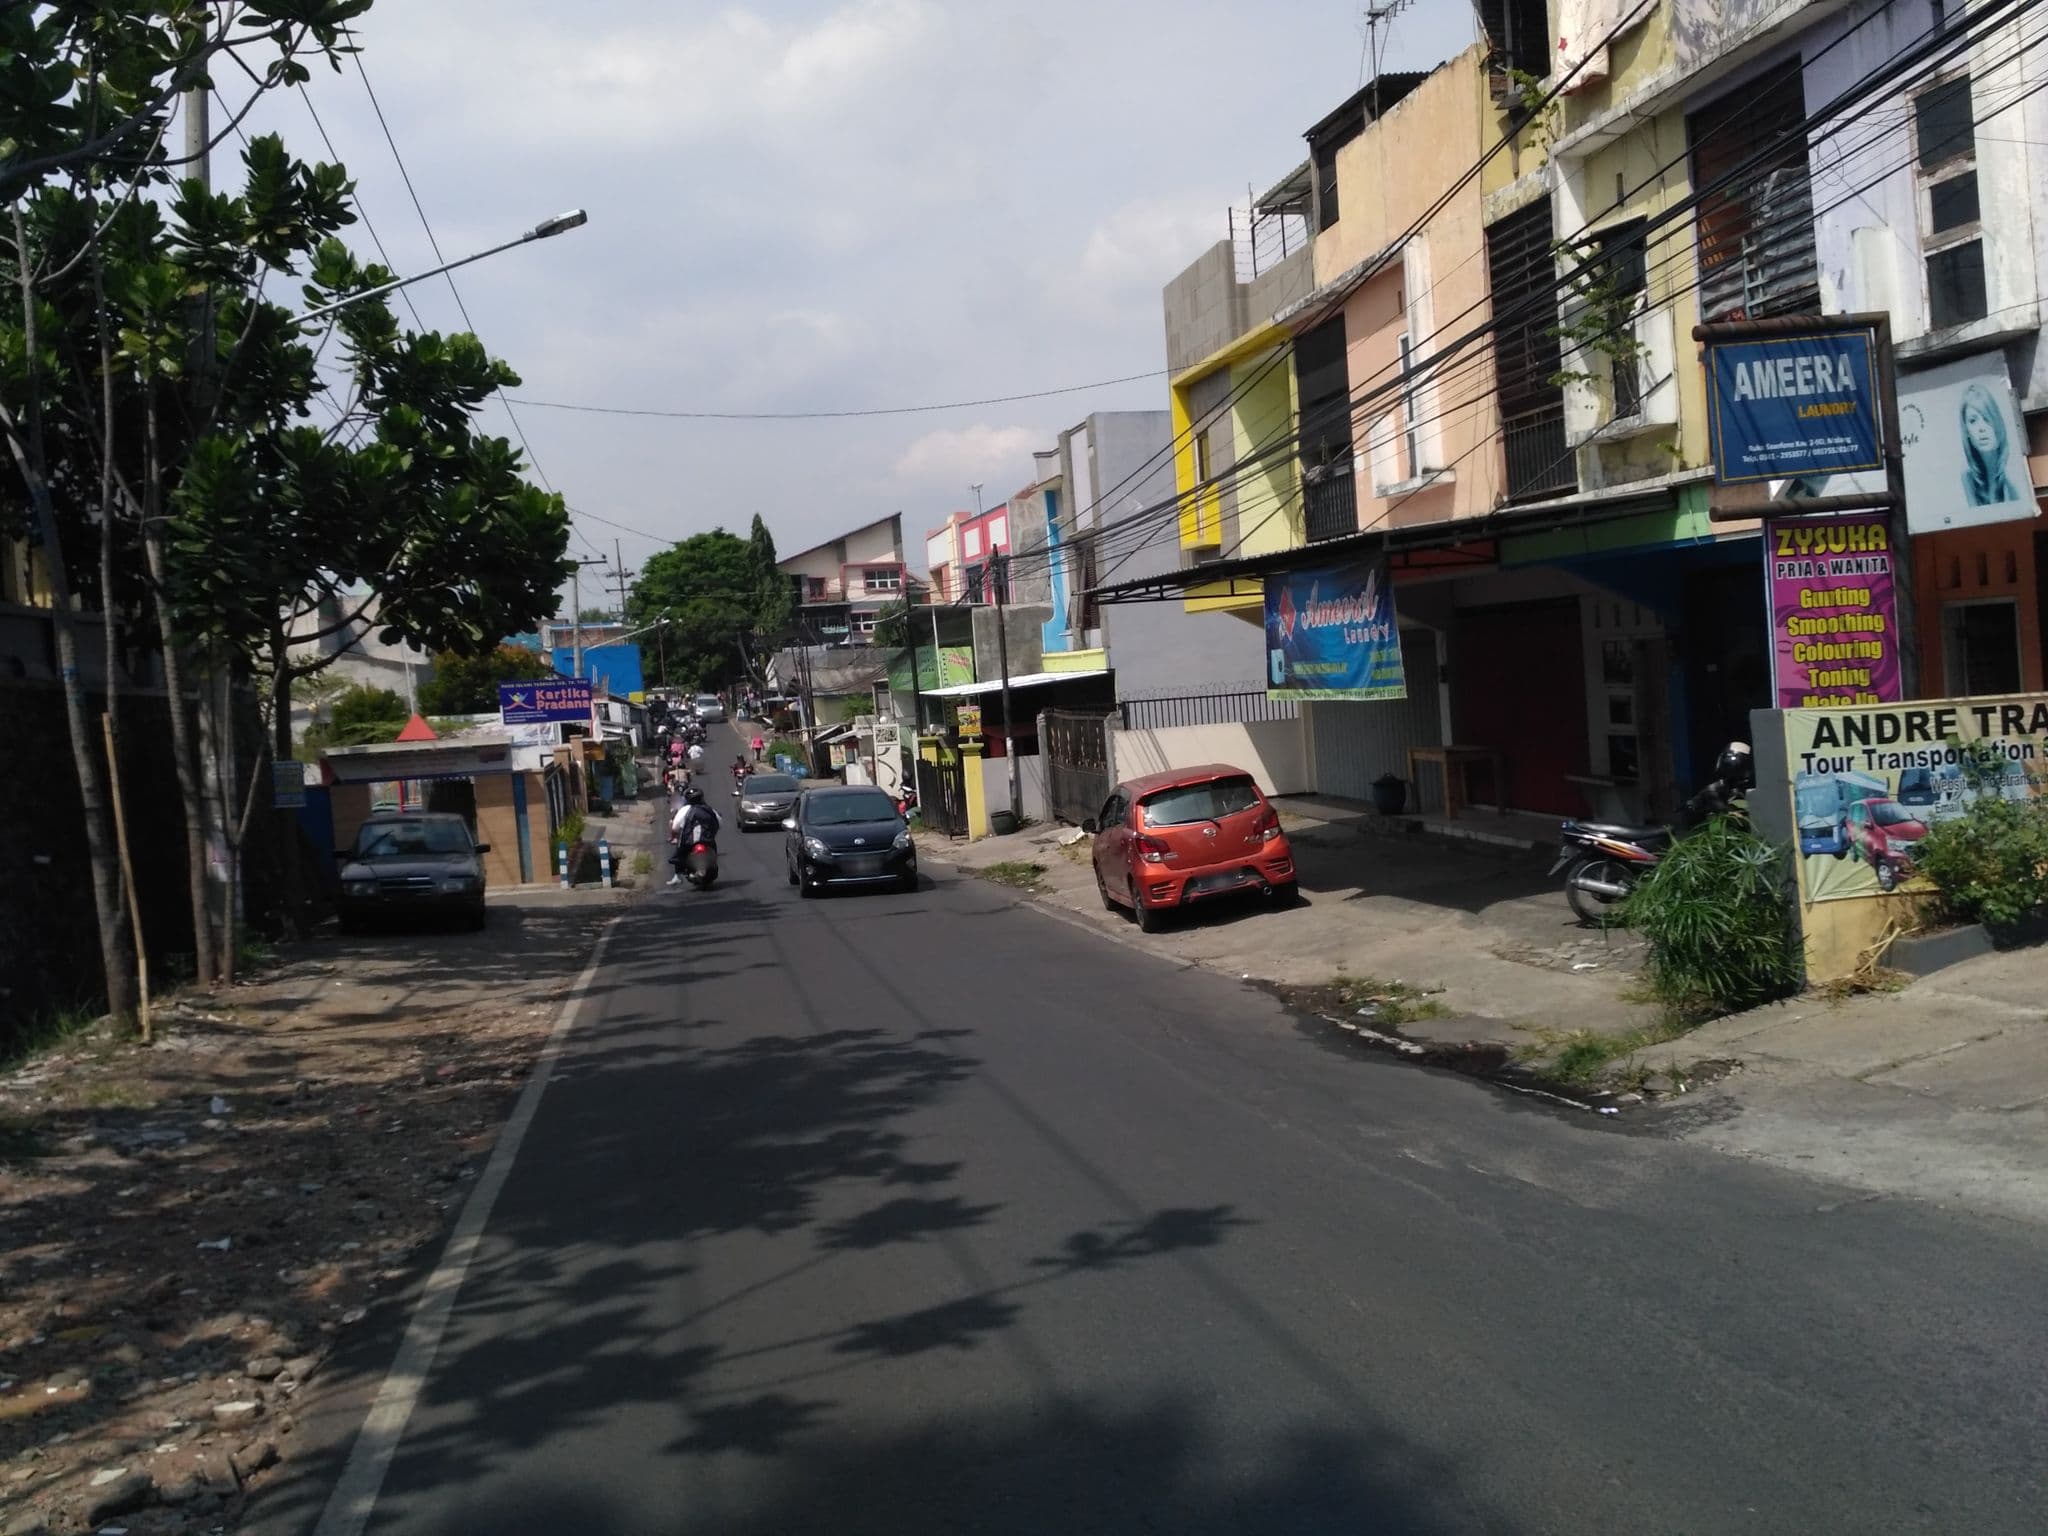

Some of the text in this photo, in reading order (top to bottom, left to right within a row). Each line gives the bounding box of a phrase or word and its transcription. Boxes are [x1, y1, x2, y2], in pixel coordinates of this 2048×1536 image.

[1734, 353, 1857, 401] AMEERA
[1798, 401, 1857, 418] LAUNDRY
[1776, 524, 1888, 556] ZYSUKA
[1777, 556, 1890, 579] PRIA & WANITA
[1800, 587, 1871, 609] Gunting
[1787, 613, 1886, 637] Smoothing
[1793, 640, 1883, 662] Colouring
[1808, 667, 1871, 689] Toning
[535, 688, 590, 700] Kartika
[536, 699, 591, 711] Pradana
[1803, 694, 1852, 708] Make
[1812, 702, 2048, 750] ANDRE TRA
[1801, 752, 1855, 776] Tour
[1930, 776, 1969, 794] Websit
